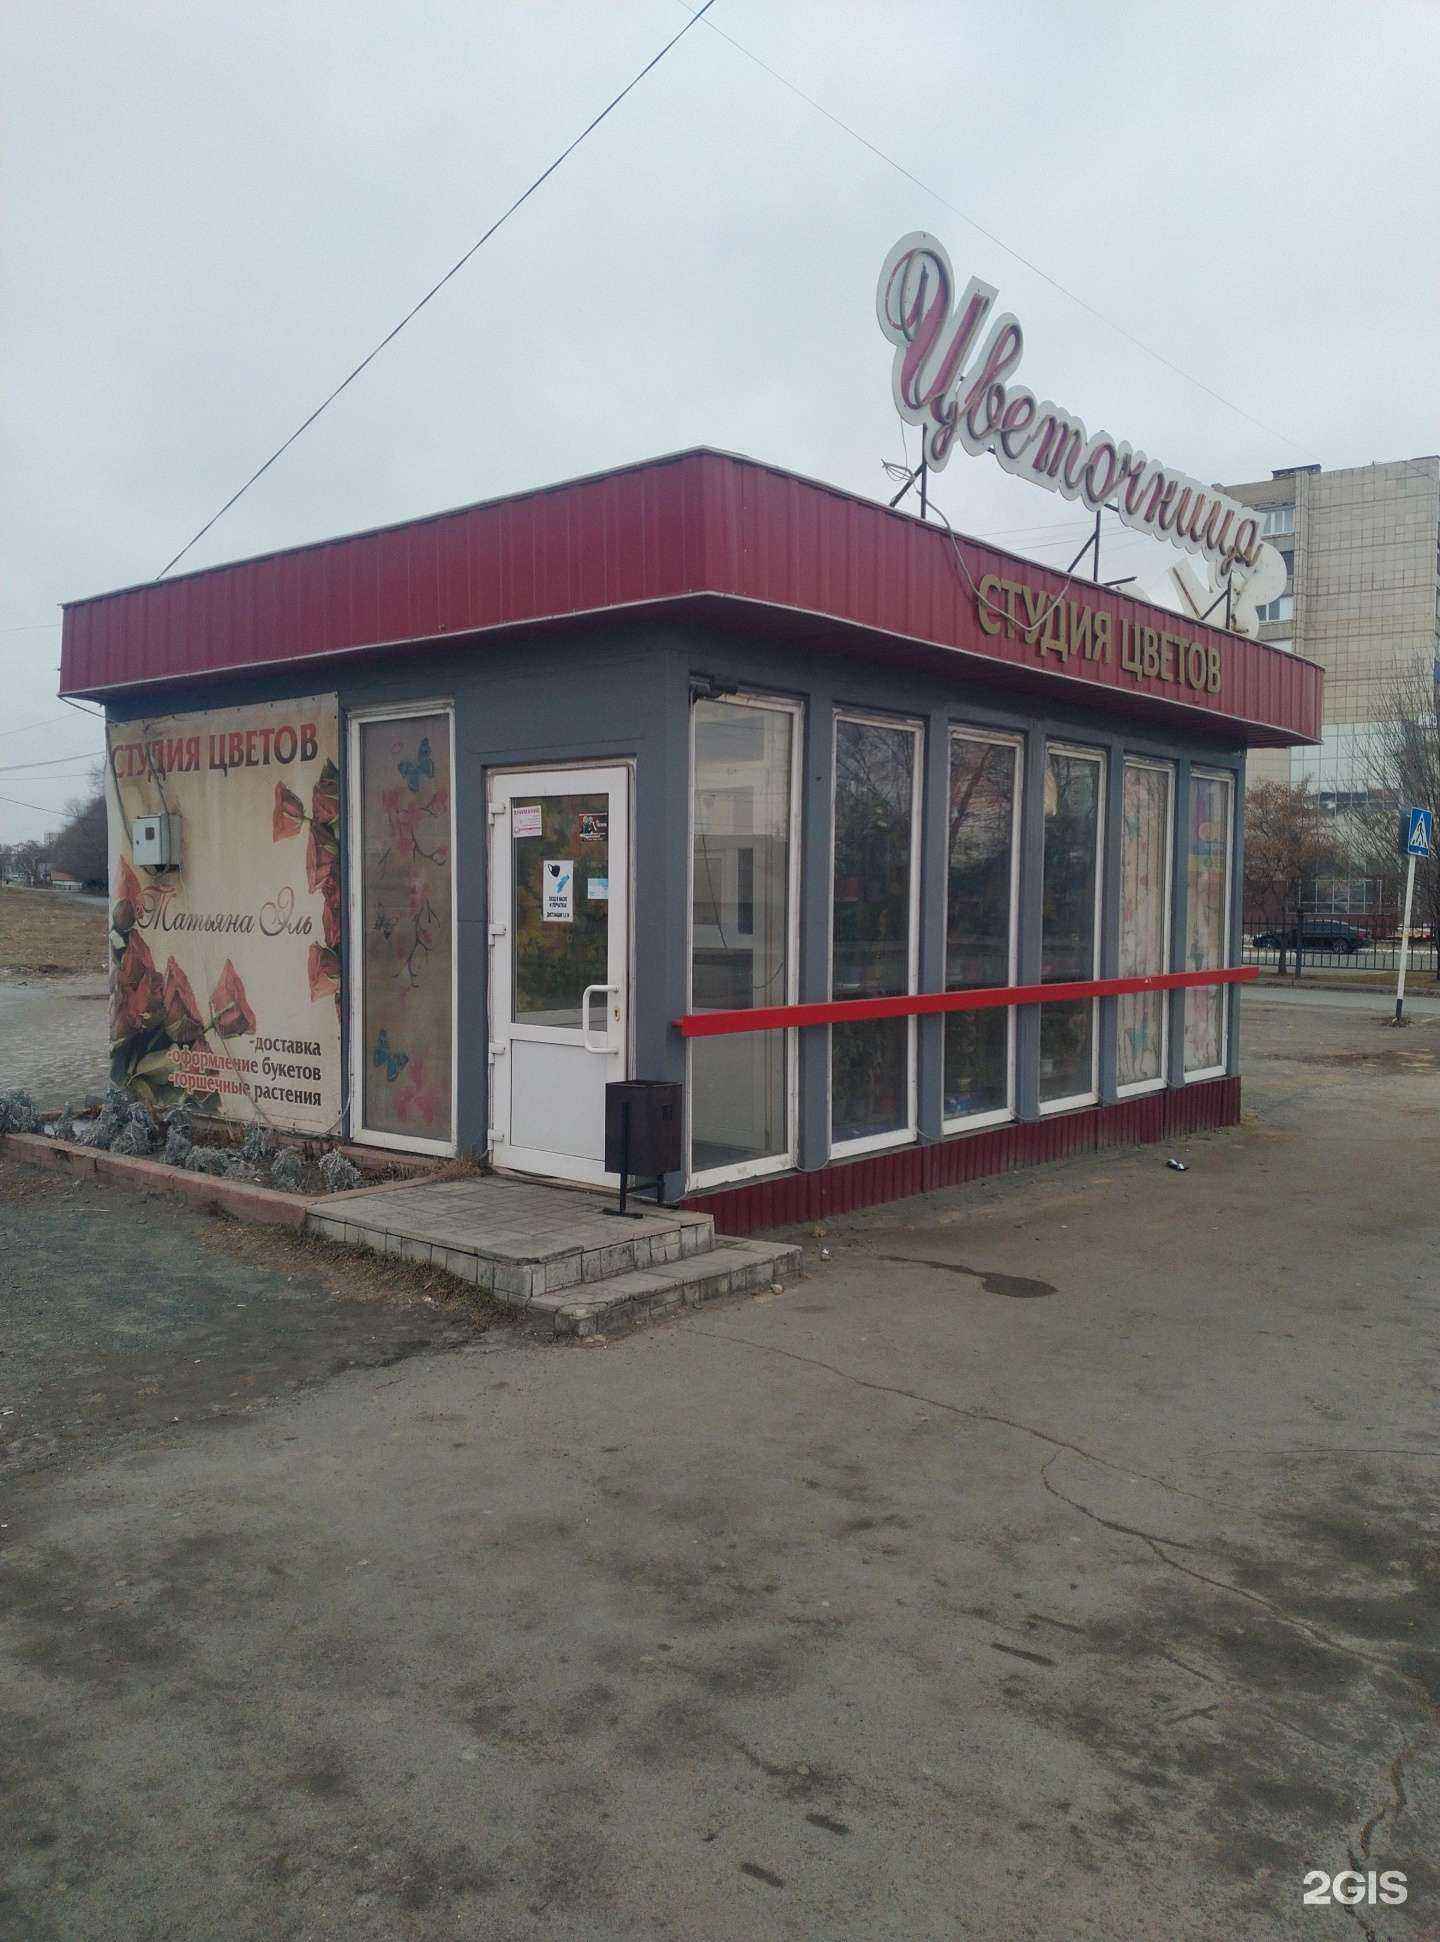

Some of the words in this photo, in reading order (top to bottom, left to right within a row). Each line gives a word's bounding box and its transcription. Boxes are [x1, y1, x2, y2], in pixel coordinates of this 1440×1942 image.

[884, 246, 1264, 577] Цветочница
[977, 573, 1113, 665] СТУДИЯ
[1119, 617, 1223, 695] ЦВЕТОВ
[111, 735, 201, 783] СТУДИЯ
[208, 722, 319, 777] ЦВЕТОВ
[136, 885, 255, 933] Татьяна
[254, 1084, 322, 1107] растения
[262, 1057, 322, 1082] букетов
